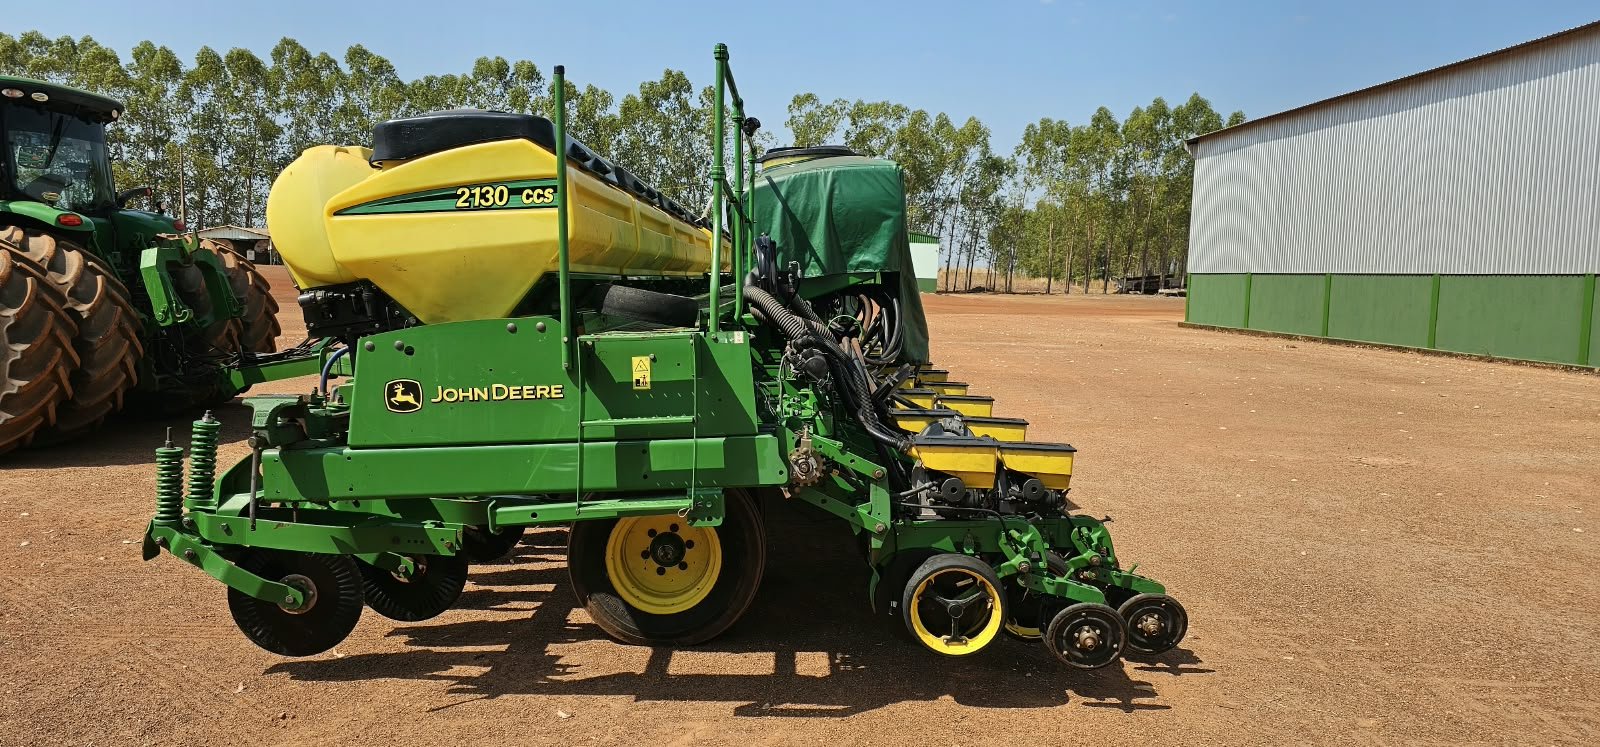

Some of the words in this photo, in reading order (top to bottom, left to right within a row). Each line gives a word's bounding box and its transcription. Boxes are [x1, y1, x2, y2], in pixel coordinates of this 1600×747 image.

[456, 185, 509, 208] 2130
[521, 188, 554, 204] CCS
[431, 385, 489, 403] JOHN
[491, 383, 564, 401] DEERE
